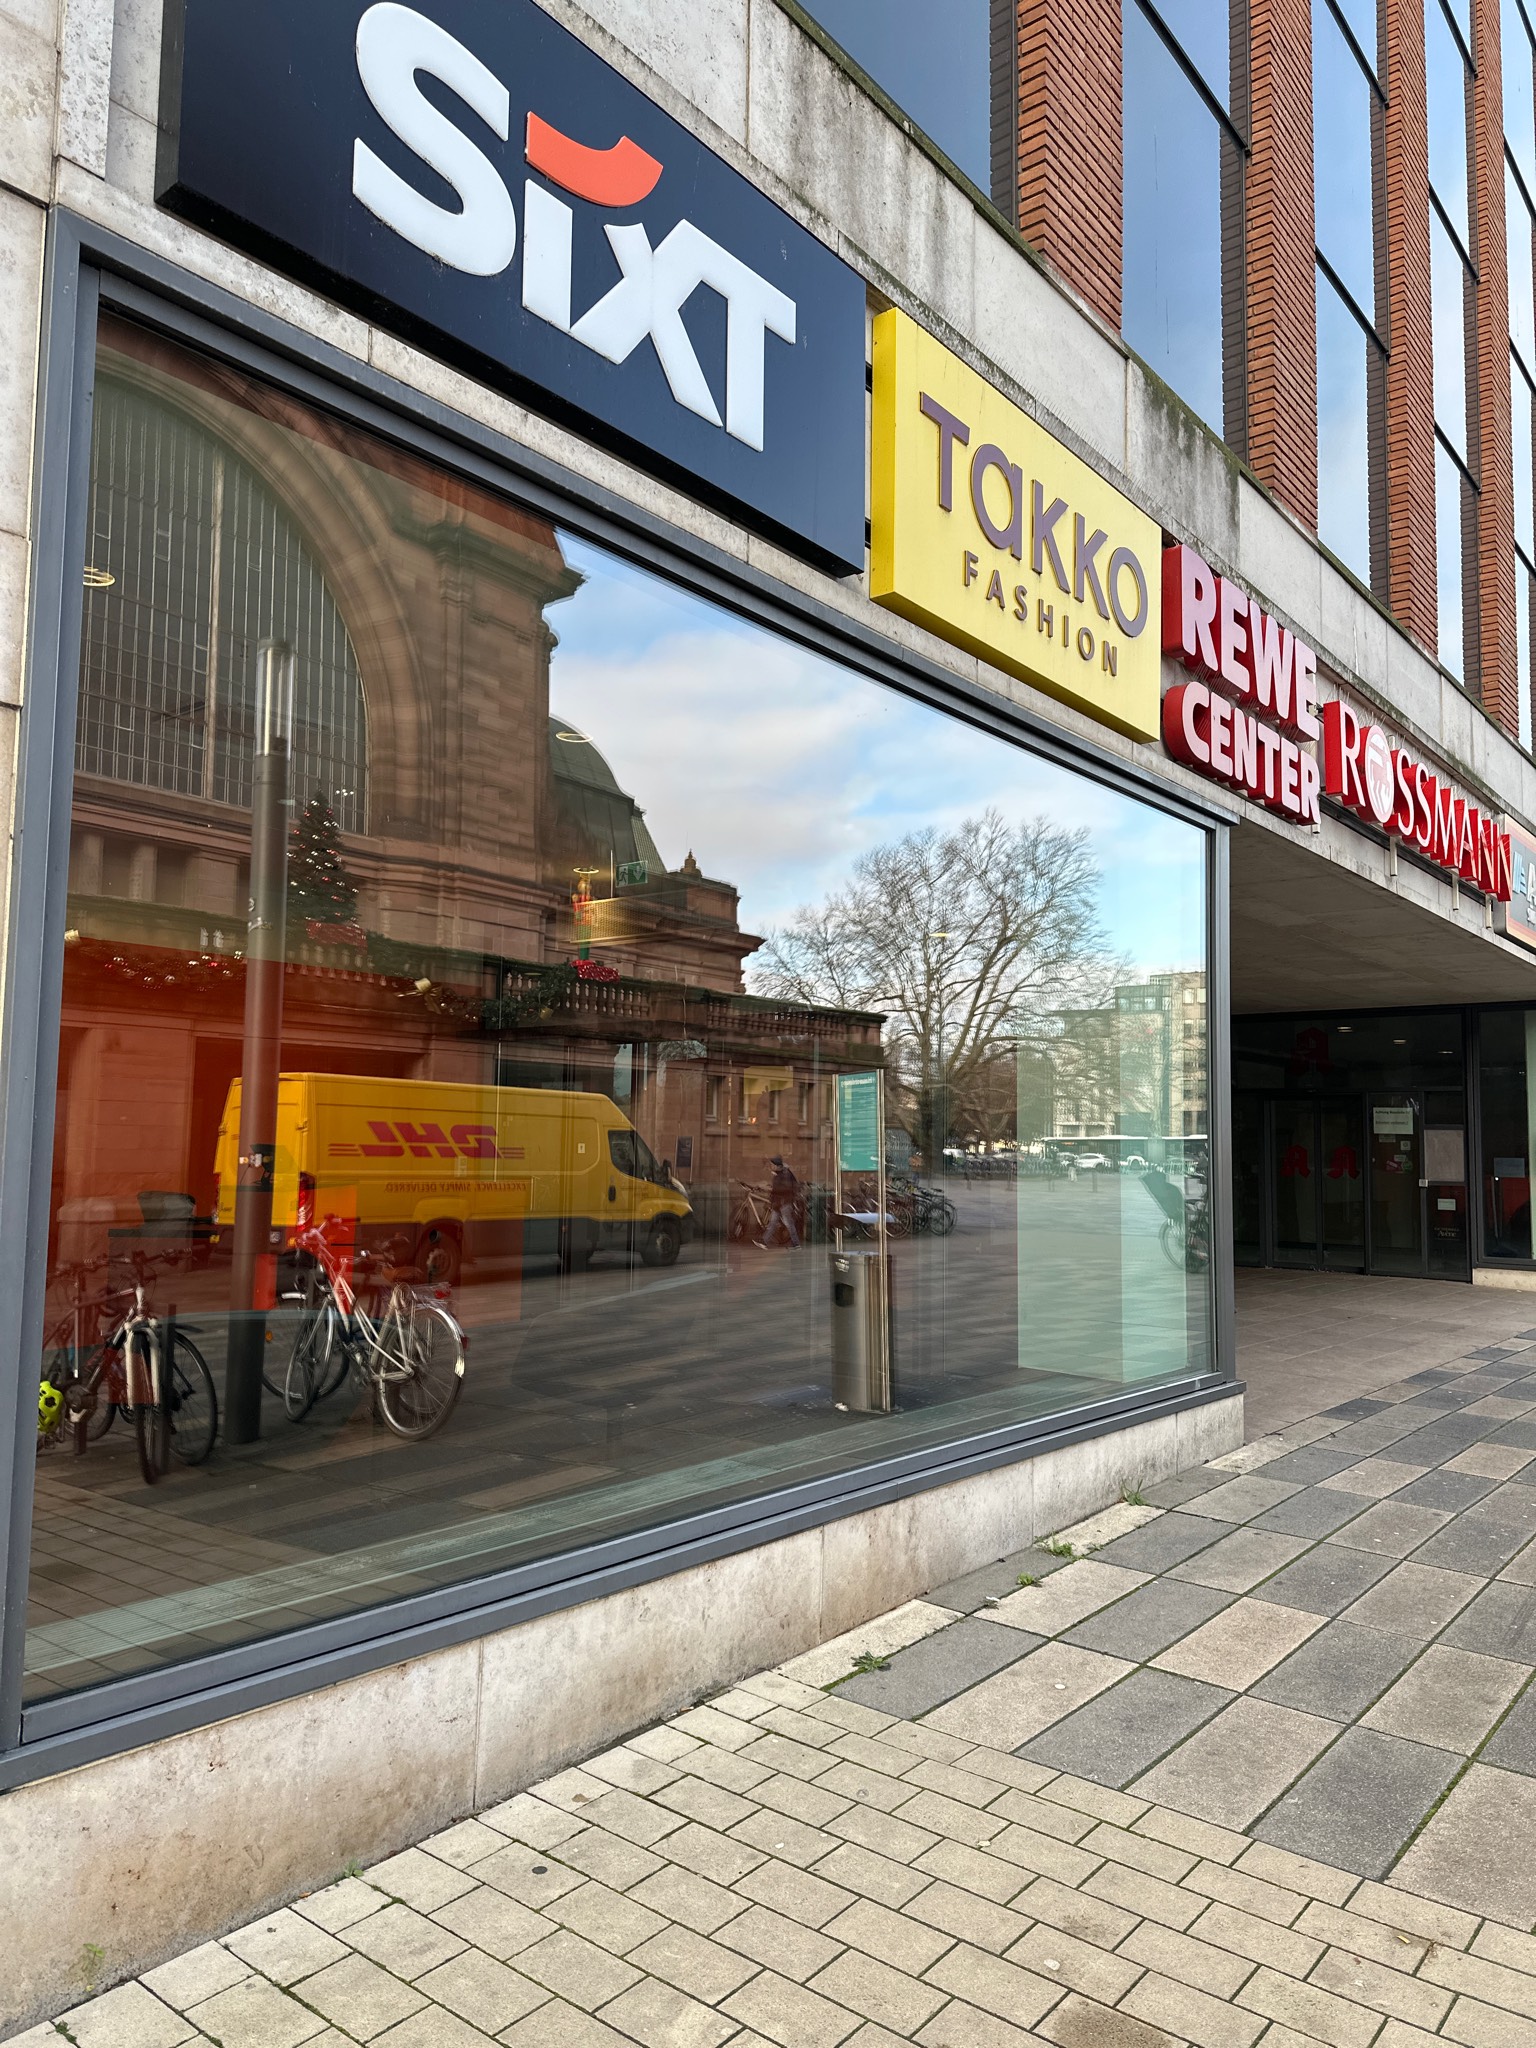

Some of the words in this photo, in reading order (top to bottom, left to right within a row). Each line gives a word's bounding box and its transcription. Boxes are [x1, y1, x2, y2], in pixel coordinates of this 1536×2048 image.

[964, 550, 1118, 677] FASHION
[1164, 544, 1320, 741] REWE
[1164, 681, 1321, 825] CENTER
[1324, 700, 1512, 901] ROSSMANN
